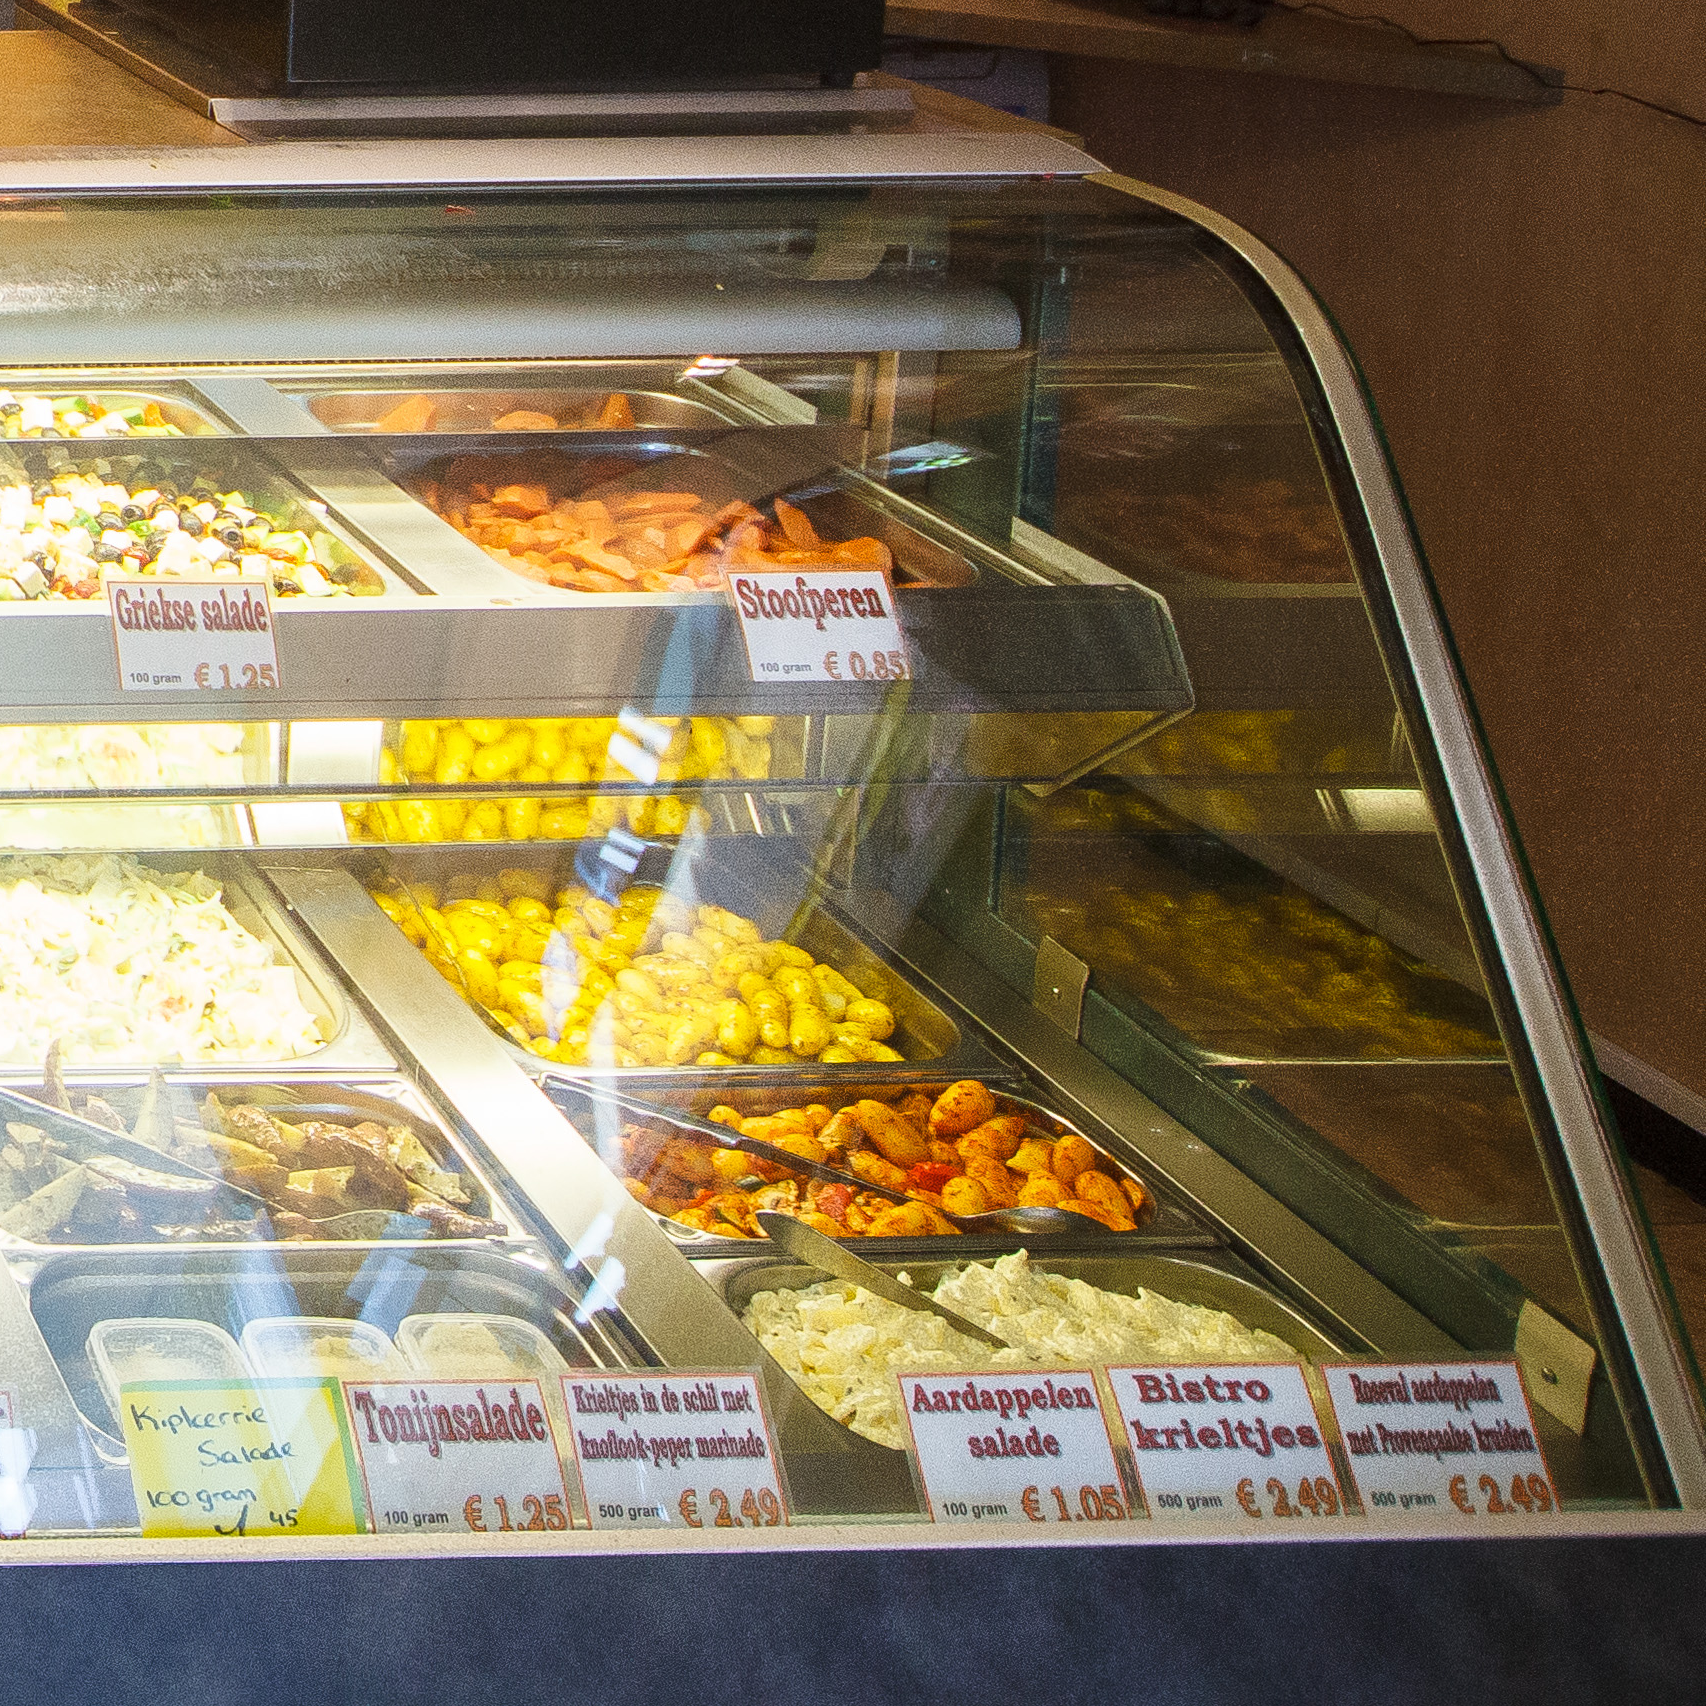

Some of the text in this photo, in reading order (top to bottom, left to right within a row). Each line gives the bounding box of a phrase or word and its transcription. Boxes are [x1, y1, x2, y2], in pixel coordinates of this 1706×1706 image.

[116, 587, 268, 631] Griekse salade
[736, 576, 887, 630] Stoofperen
[130, 673, 150, 683] 100
[152, 674, 182, 685] gram
[218, 663, 276, 689] 1.25
[849, 651, 905, 680] 0.85
[572, 1382, 753, 1421] Krieltjes in de schil met
[912, 1379, 1095, 1419] Aardappelen
[1132, 1372, 1270, 1405] Bistro
[130, 1404, 268, 1435] Kipkerrie
[354, 1389, 547, 1457] Tonijnsalade
[1129, 1417, 1320, 1457] krieltjes
[695, 1427, 765, 1458] marinade
[967, 1425, 1061, 1459] salade
[146, 1487, 257, 1512] 100 gram
[710, 1488, 781, 1528] 2.49
[942, 1502, 968, 1516] 100
[971, 1502, 1008, 1519] gram
[1051, 1485, 1126, 1522] 1.05
[1266, 1476, 1338, 1517] 2.49
[1479, 1474, 1552, 1513] 2.49
[498, 1494, 567, 1532] 1.25
